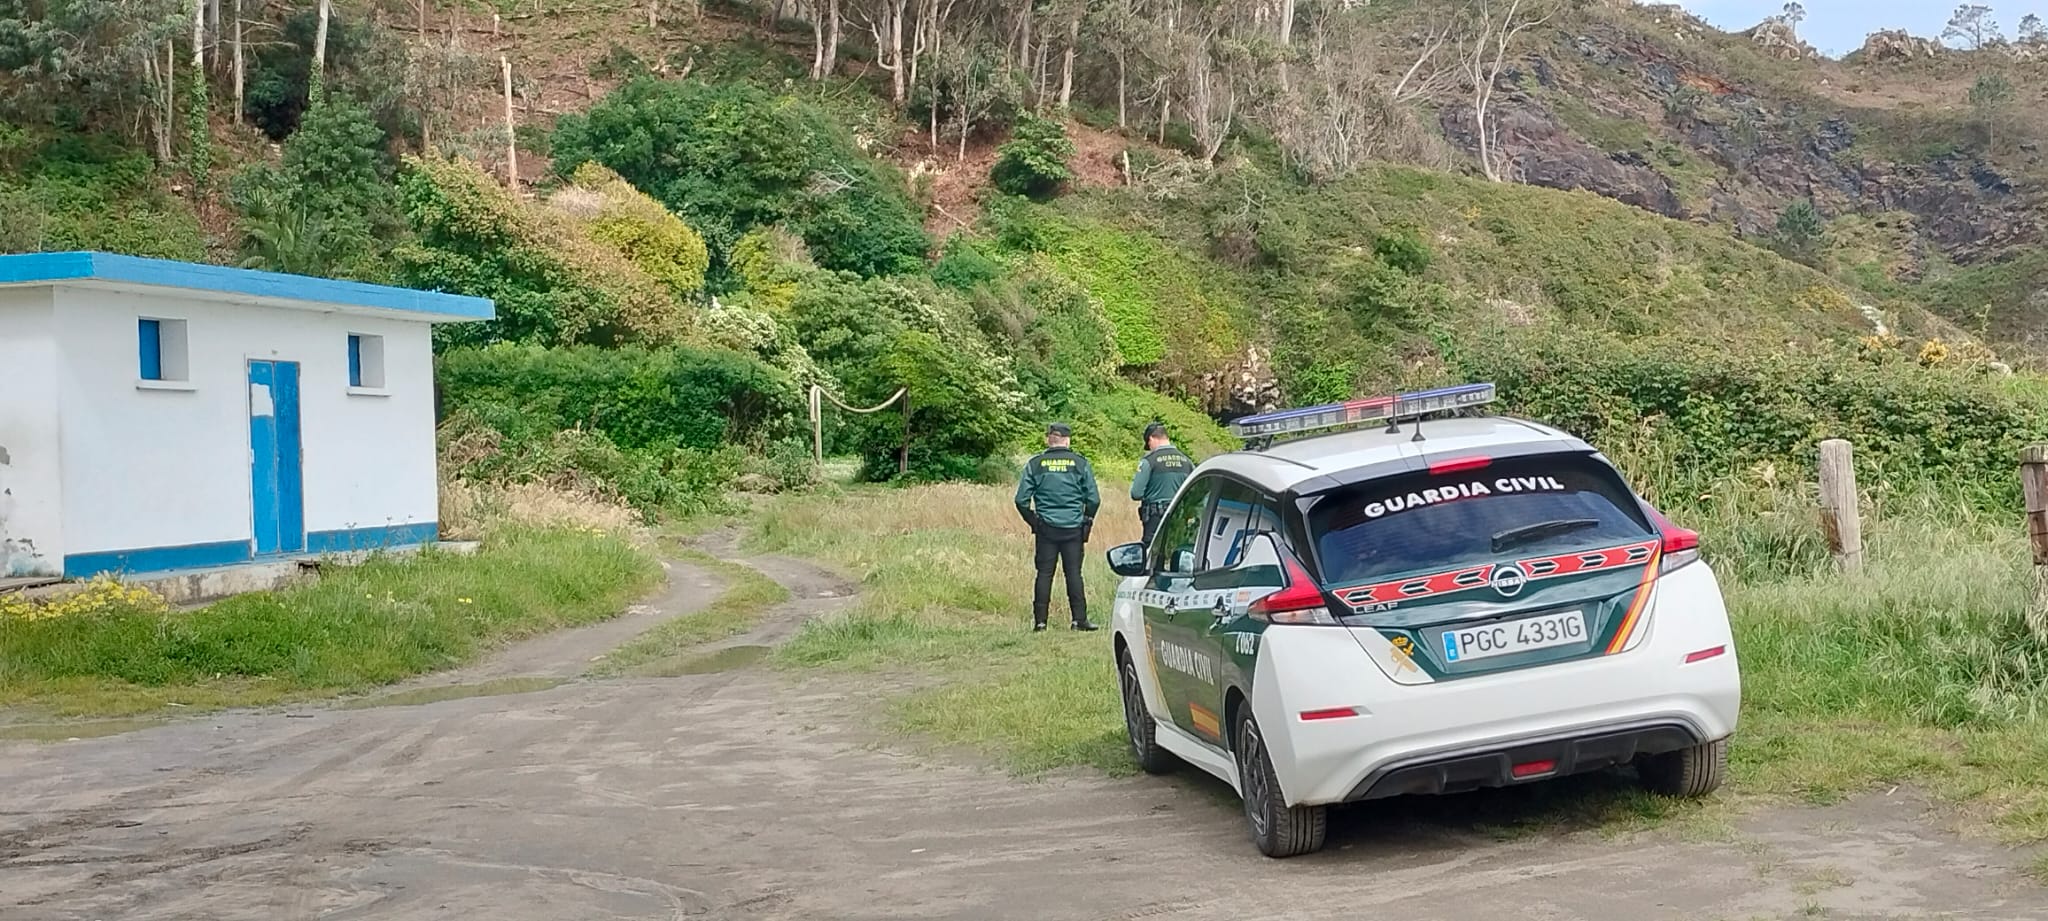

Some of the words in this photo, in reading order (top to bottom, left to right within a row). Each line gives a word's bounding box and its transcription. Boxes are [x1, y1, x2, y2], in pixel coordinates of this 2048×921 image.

[1041, 459, 1075, 467] GUARDIA
[1157, 454, 1187, 462] GUARDIA
[1364, 481, 1491, 517] GUARDIA
[1495, 476, 1564, 492] CIVIL
[1491, 576, 1526, 588] NISSAN
[1353, 601, 1398, 614] LEAF
[1461, 628, 1507, 654] PGC
[1517, 616, 1581, 645] 4331G
[1161, 639, 1196, 677] GUARDIA
[1194, 651, 1214, 685] CIVIL
